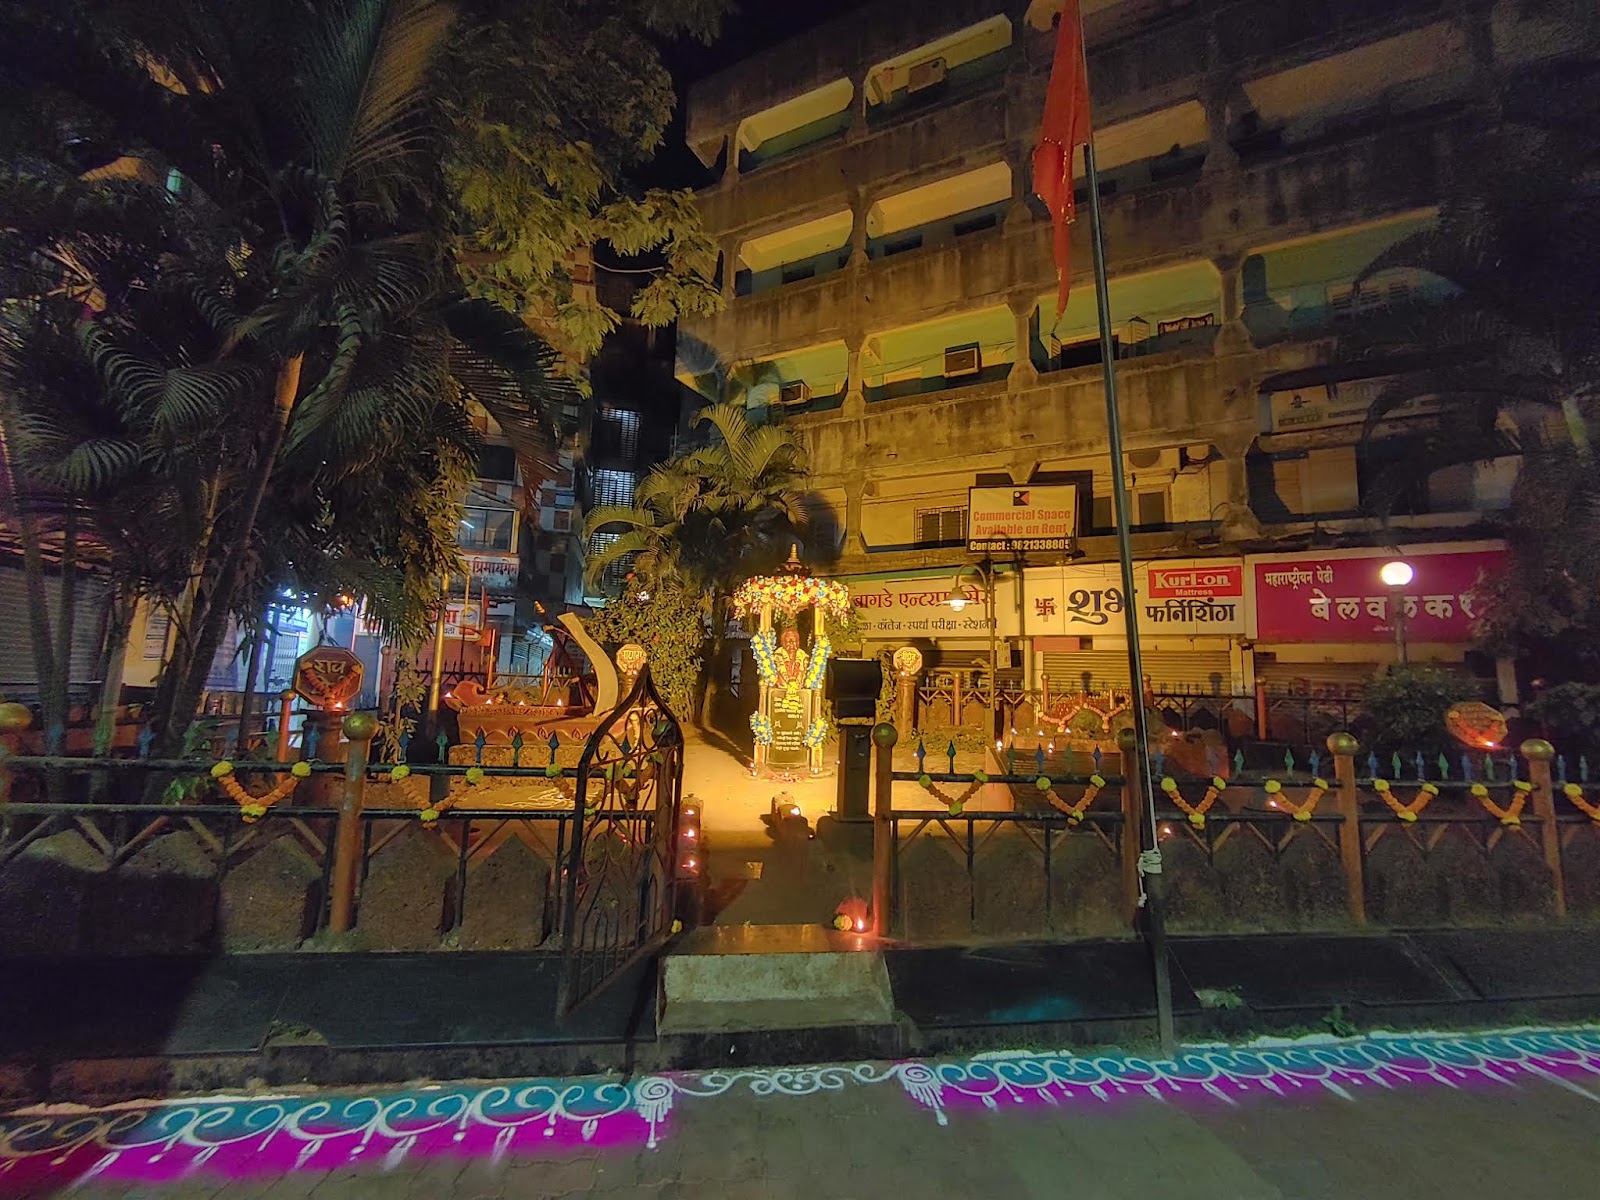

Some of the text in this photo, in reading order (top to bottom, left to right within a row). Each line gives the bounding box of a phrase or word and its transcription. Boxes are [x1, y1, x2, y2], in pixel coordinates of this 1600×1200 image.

[974, 509, 1071, 521] Commercial Space
[976, 523, 1067, 535] Available on Rent
[1154, 571, 1231, 589] Kurl-on
[1175, 588, 1214, 596] Mattress
[1145, 596, 1236, 623] फर्निशिंग
[877, 618, 901, 631] कॉलेज
[931, 617, 957, 631] परीक्षा
